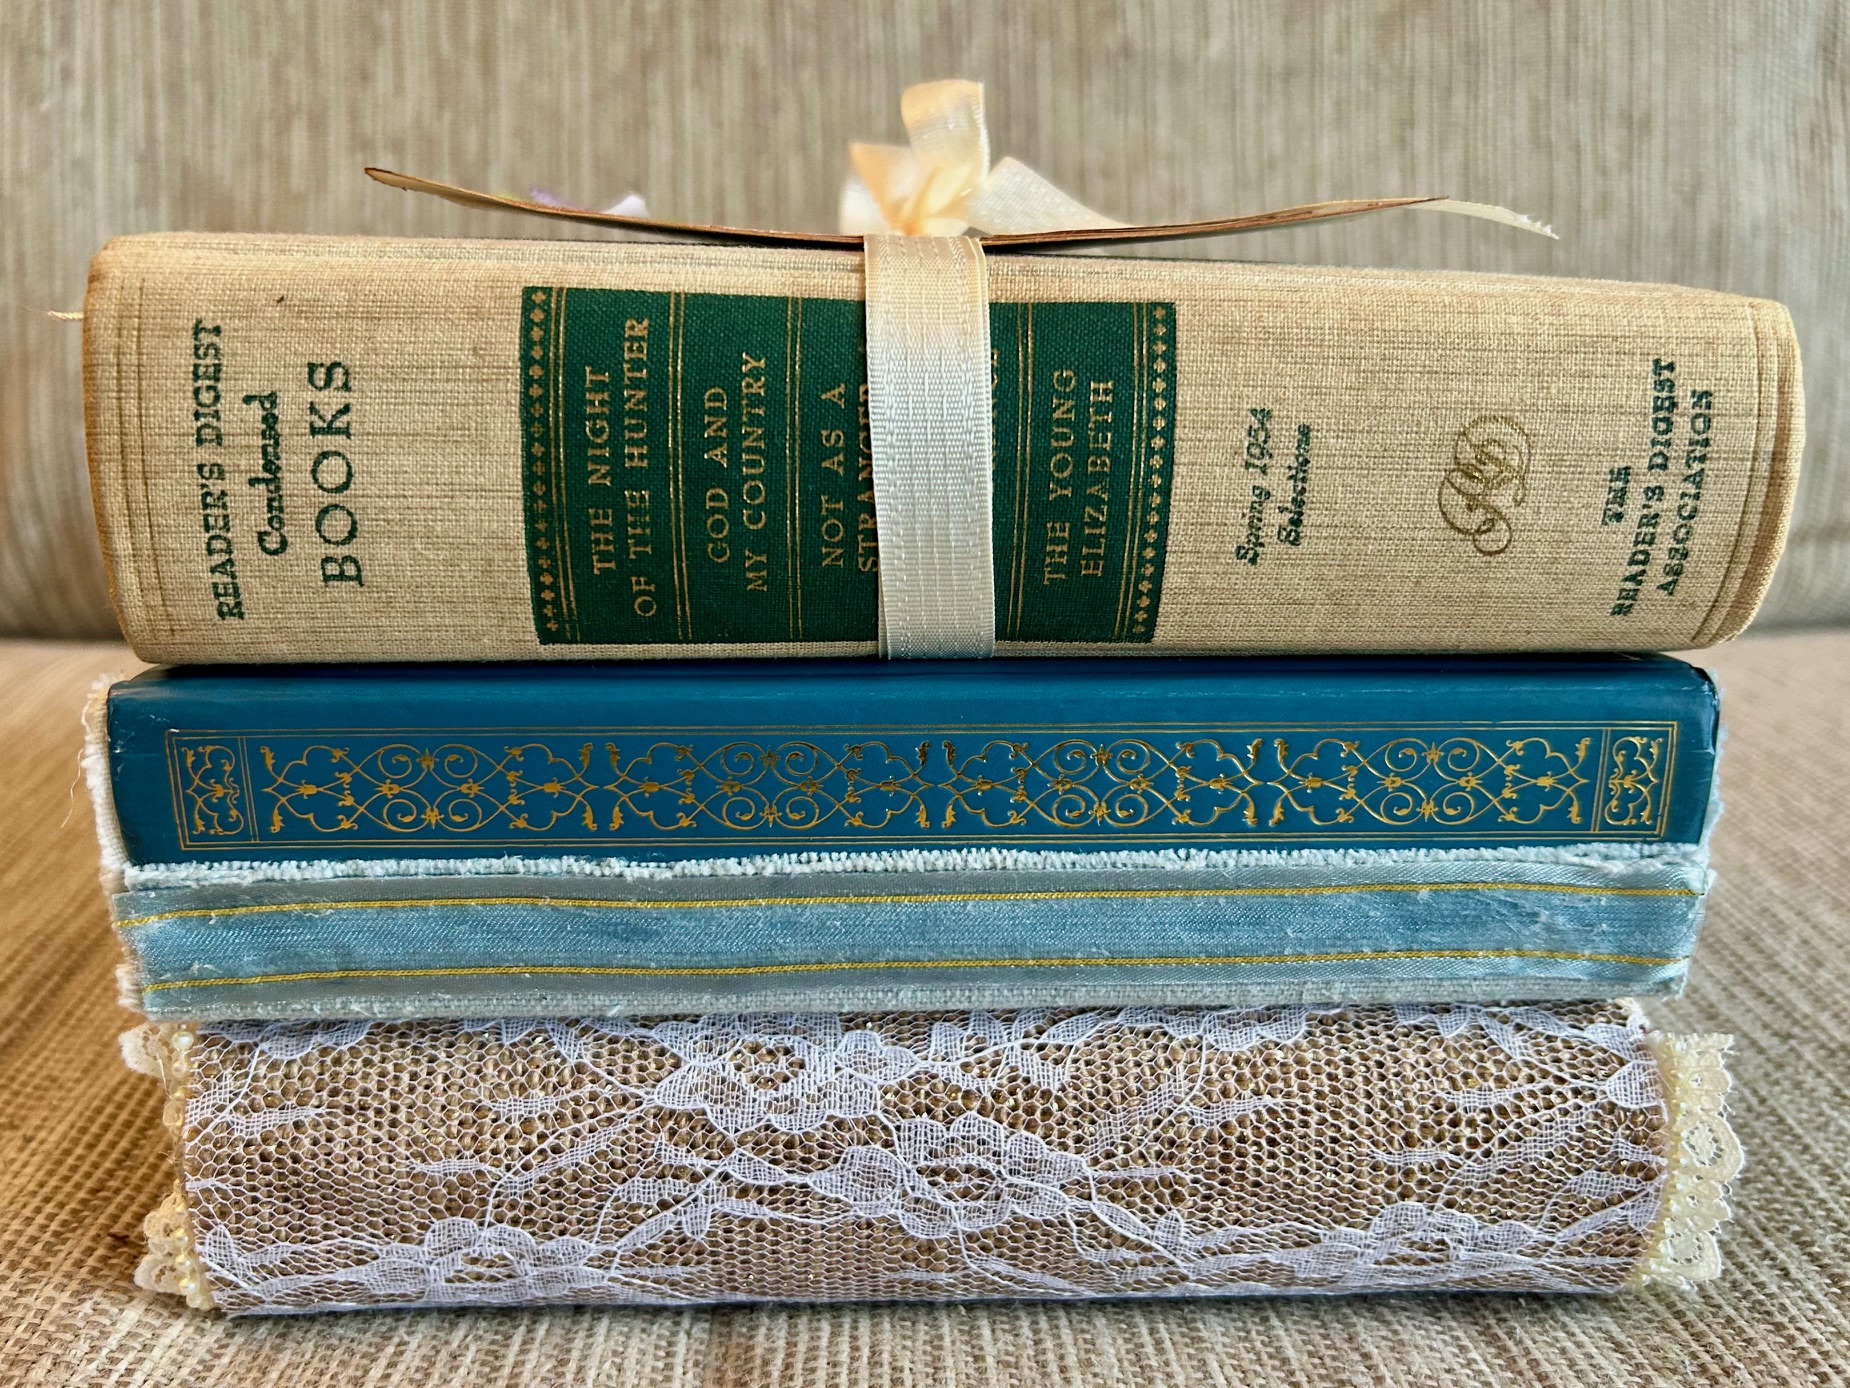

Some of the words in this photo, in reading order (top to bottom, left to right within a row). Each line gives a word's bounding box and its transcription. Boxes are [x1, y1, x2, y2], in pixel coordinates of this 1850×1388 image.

[193, 317, 223, 448] DIGEST
[623, 316, 650, 469] HUNTER
[820, 382, 846, 410] A
[585, 365, 612, 487] NIGHT
[704, 386, 728, 468] AND
[742, 351, 768, 531] COUNTRY
[821, 429, 845, 477] AS
[1049, 368, 1076, 501] YOUNG
[1245, 407, 1272, 476] 1954
[242, 390, 289, 556] Condensed
[307, 361, 364, 588] BOOKS
[1081, 379, 1114, 577] ELIZABETH
[1277, 423, 1311, 547] Selections
[1601, 465, 1632, 527] THE
[1611, 484, 1665, 617] READER'S
[1647, 357, 1678, 472] DIGEST
[1656, 388, 1713, 597] ASSOCIATION
[197, 462, 246, 621] READER'S
[588, 507, 618, 575] THE
[625, 489, 652, 560] THE
[705, 487, 731, 564] GOD
[821, 494, 845, 568] NOT
[1043, 521, 1071, 585] THE
[1235, 485, 1271, 566] Spring
[630, 575, 657, 618] OF
[745, 548, 768, 593] MY
